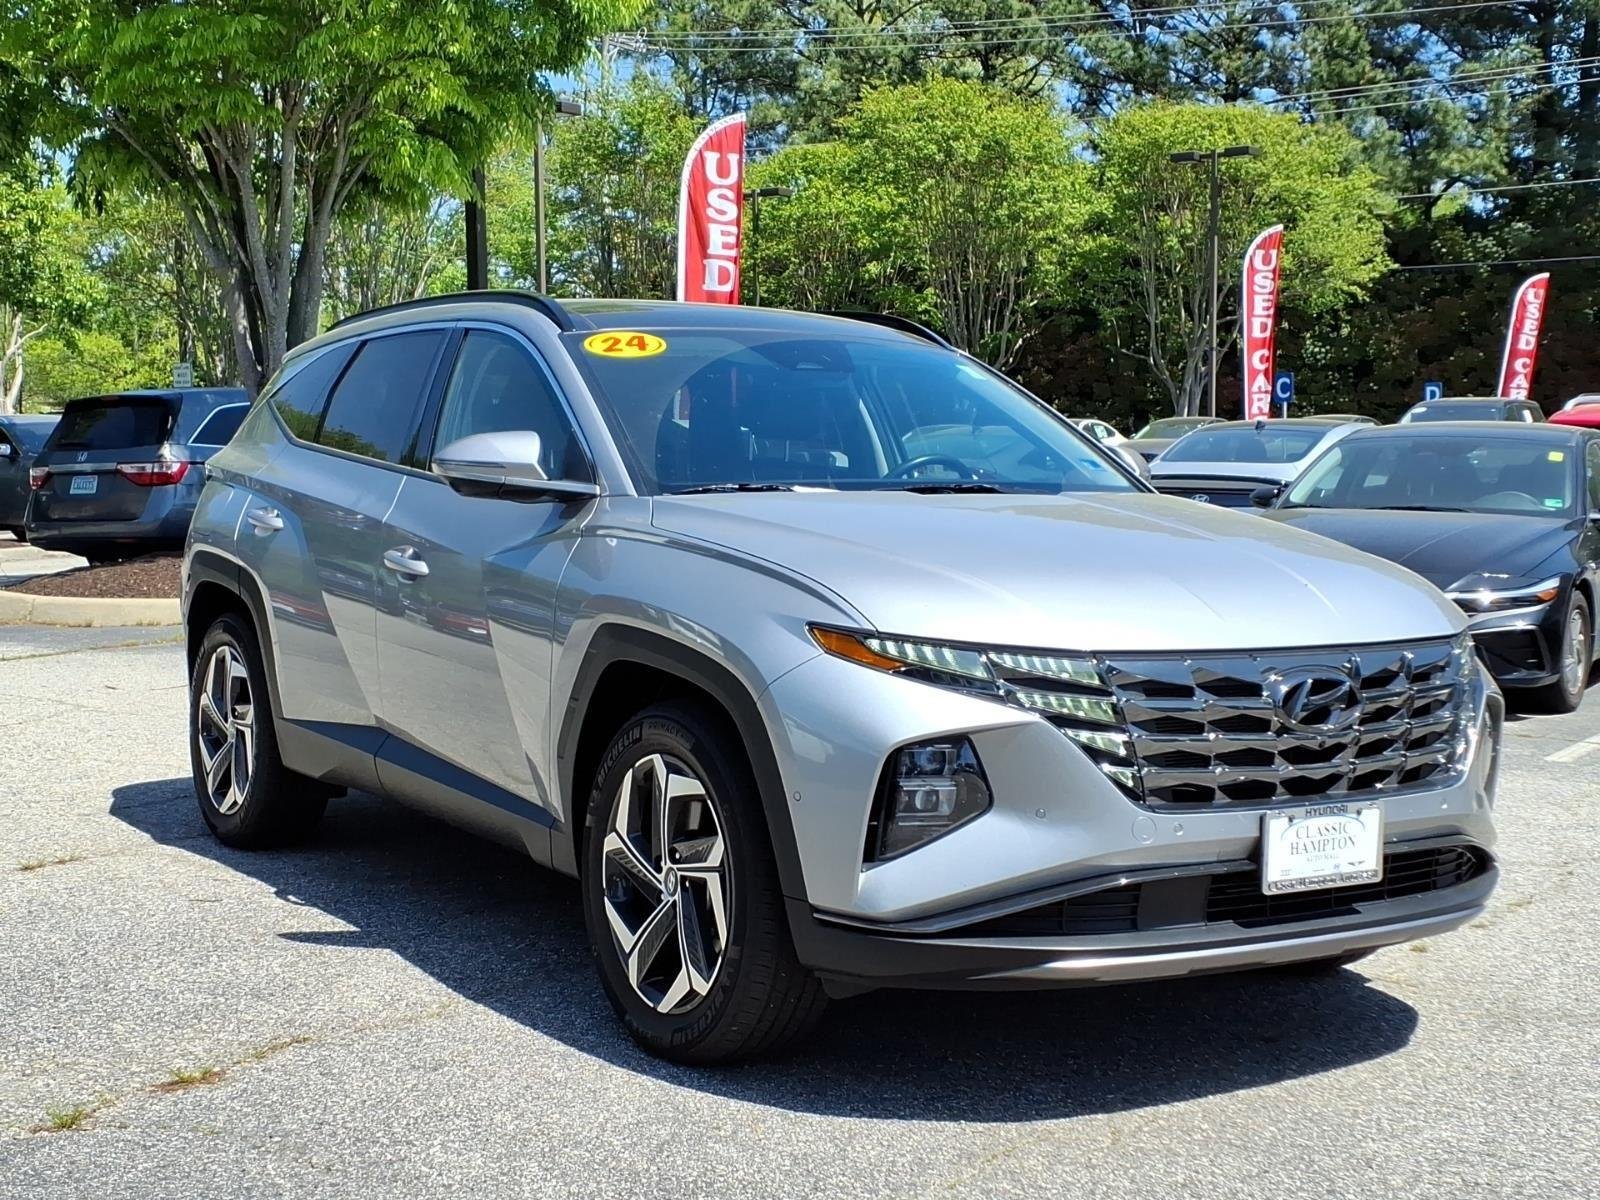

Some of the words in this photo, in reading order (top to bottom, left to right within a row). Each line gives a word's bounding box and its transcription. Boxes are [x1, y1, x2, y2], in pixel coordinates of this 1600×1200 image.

[703, 151, 739, 292] USED
[1252, 249, 1278, 338] USED
[1518, 288, 1545, 350] USED
[601, 336, 648, 352] 24
[1251, 350, 1271, 420] CAR
[1276, 377, 1291, 398] C
[598, 726, 641, 788] MICHELIN
[1296, 822, 1351, 839] CLASSIC
[1305, 804, 1348, 817] HYUNDAI
[1291, 836, 1355, 855] HAMPTON
